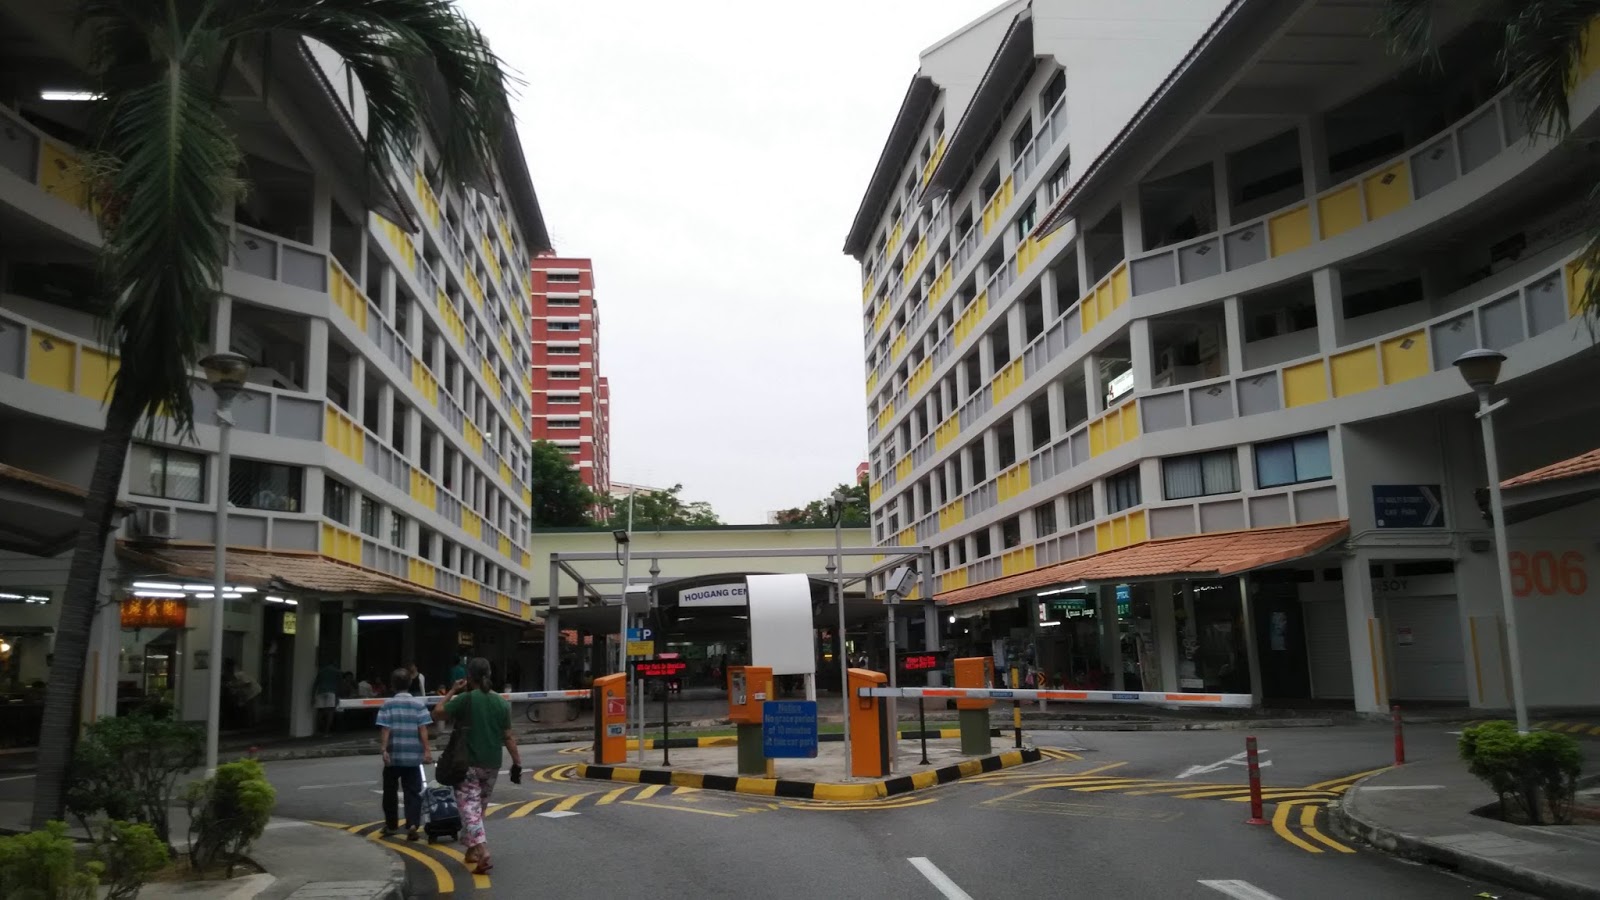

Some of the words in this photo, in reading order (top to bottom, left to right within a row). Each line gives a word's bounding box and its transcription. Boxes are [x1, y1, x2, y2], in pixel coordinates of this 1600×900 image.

[684, 589, 729, 601] HOUGANG
[643, 629, 651, 639] P
[778, 704, 801, 712] Notice
[765, 714, 774, 722] No
[775, 715, 793, 724] grace
[794, 714, 815, 724] period
[799, 737, 814, 747] park
